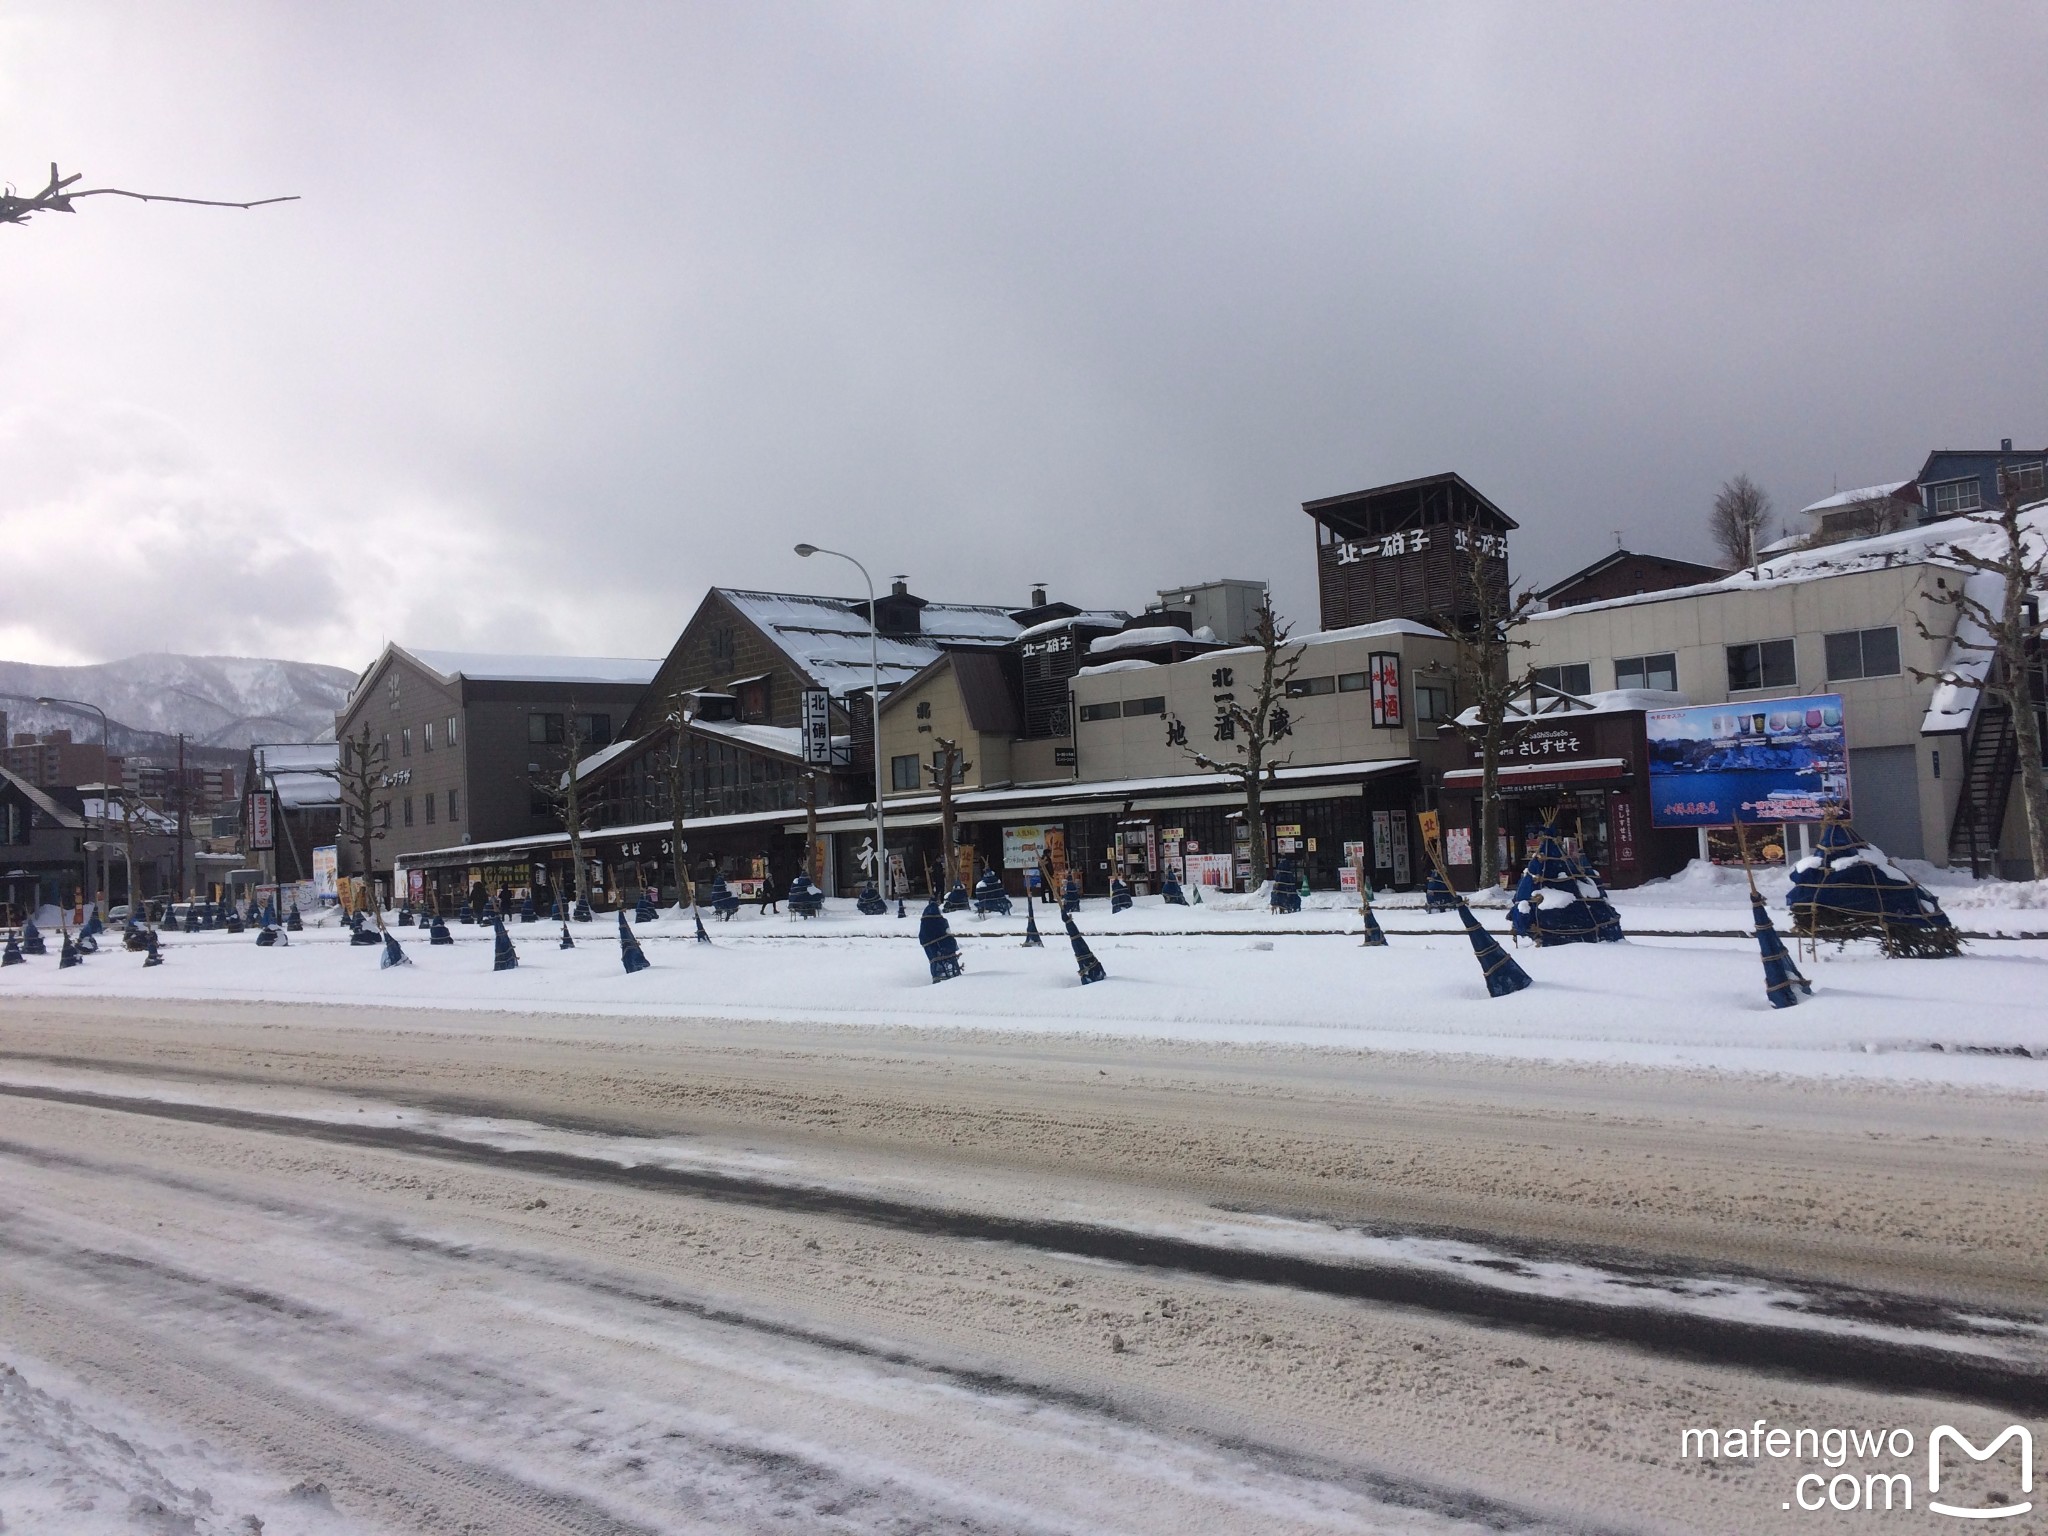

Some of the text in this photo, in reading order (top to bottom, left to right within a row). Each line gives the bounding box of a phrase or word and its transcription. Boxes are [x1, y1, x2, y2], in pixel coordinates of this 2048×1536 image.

[1337, 529, 1429, 565] 北一硝子
[1022, 636, 1071, 658] 北一硝子
[1383, 662, 1398, 719] 地酒
[811, 694, 827, 759] 北一硝子
[1518, 738, 1580, 756] さしすせそ
[621, 841, 641, 857] そば
